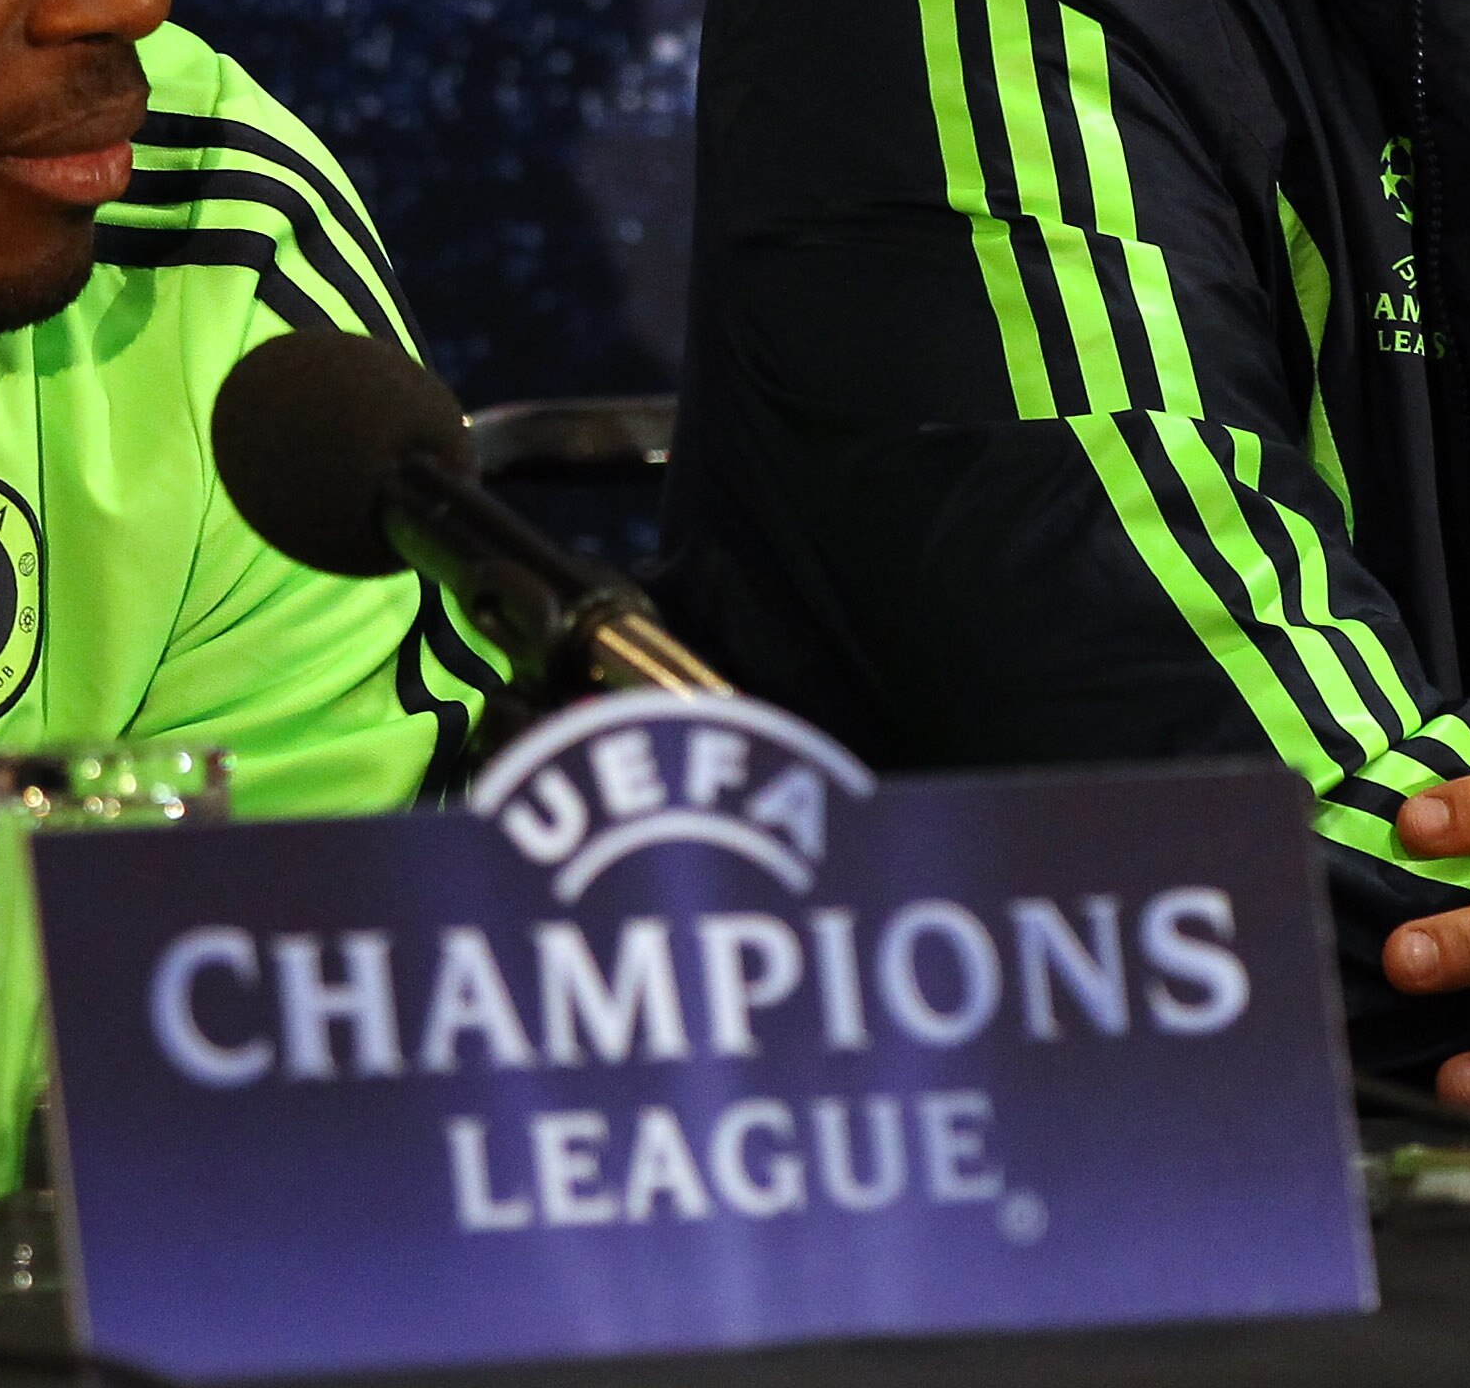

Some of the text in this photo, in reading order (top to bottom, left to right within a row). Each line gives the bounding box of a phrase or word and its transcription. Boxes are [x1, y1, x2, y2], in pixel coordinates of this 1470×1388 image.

[503, 727, 829, 867] UEFA
[151, 886, 1251, 1088] CHAMPIONS
[445, 1092, 1003, 1234] LEAGUE
